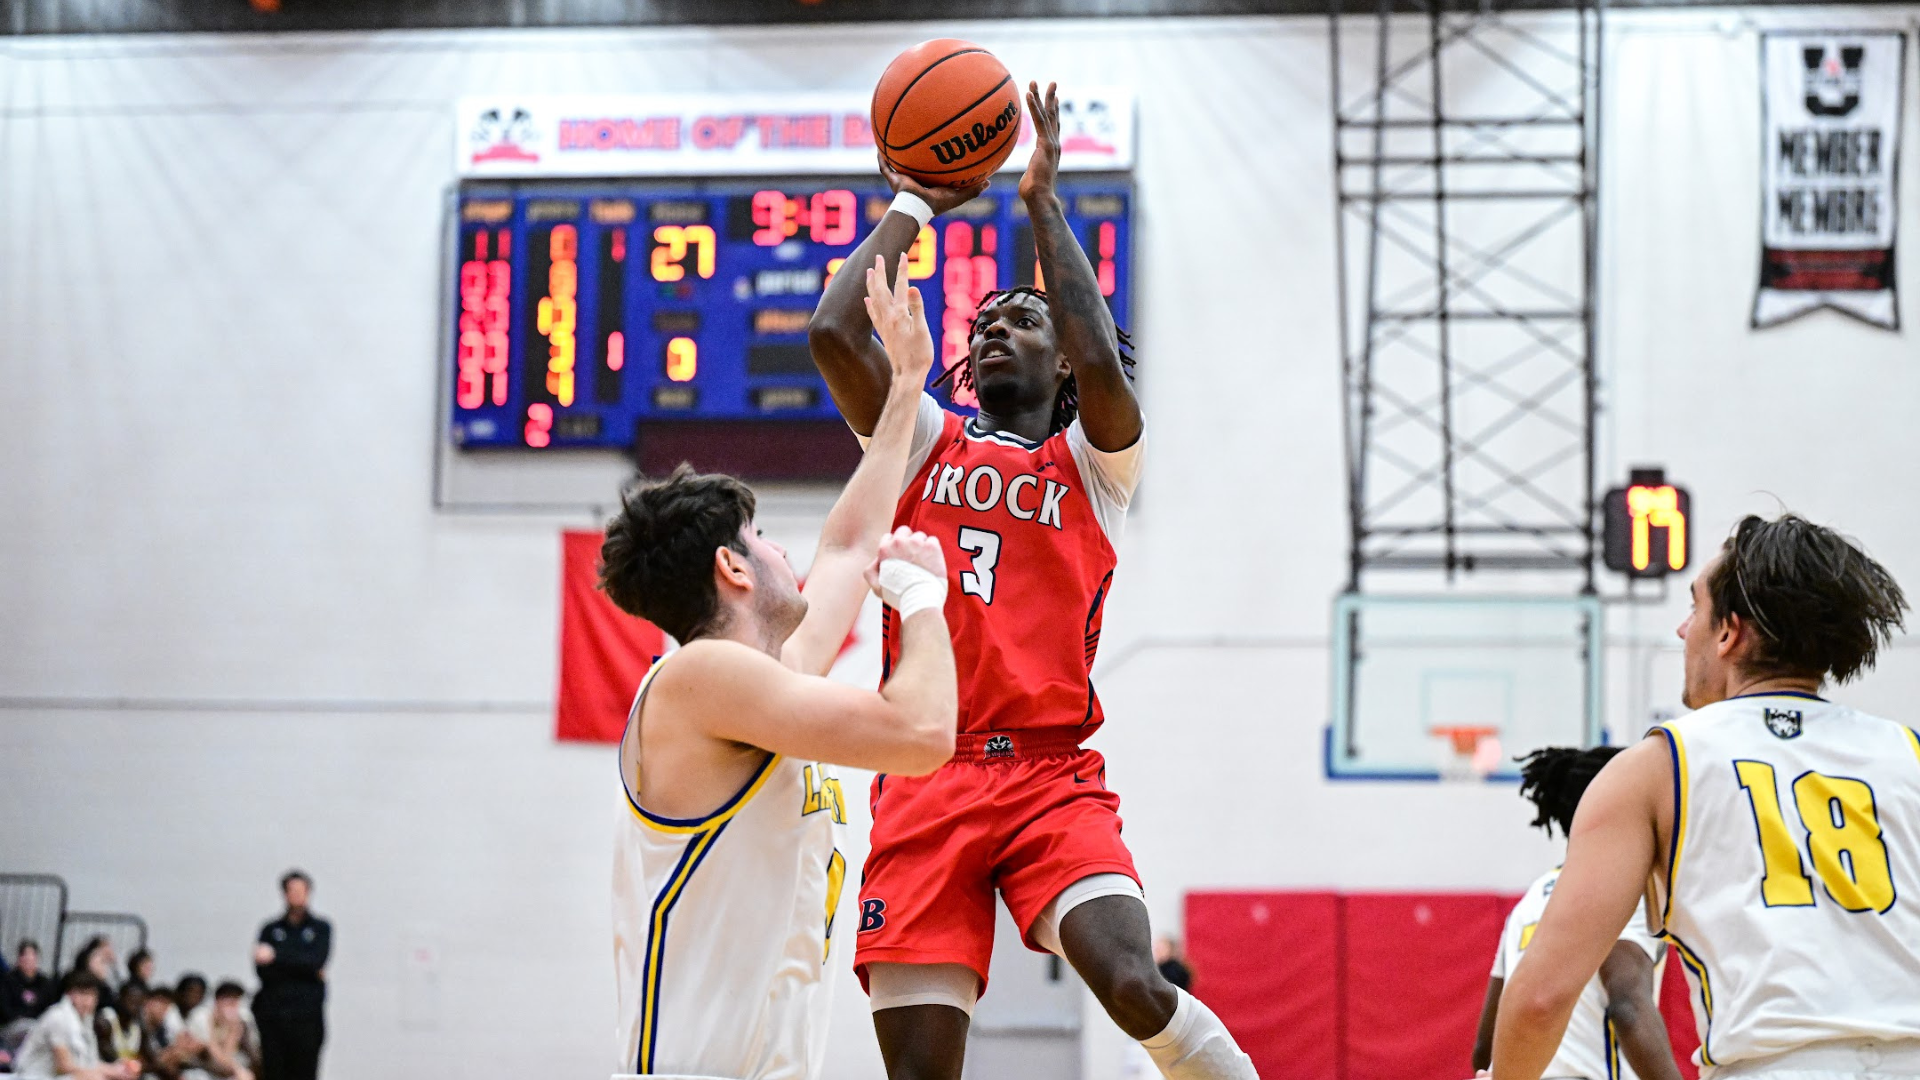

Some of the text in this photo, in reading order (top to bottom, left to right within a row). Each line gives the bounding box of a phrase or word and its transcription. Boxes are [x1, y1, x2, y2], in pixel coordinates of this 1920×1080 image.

[559, 116, 681, 151] HOME
[930, 99, 1018, 165] Wilson
[1777, 129, 1882, 176] MEMBER
[752, 189, 857, 247] 9:43
[1775, 188, 1880, 234] MEMBRE
[650, 225, 716, 282] 27
[958, 525, 1002, 605] 3
[1732, 758, 1897, 915] 18
[857, 898, 889, 934] B
